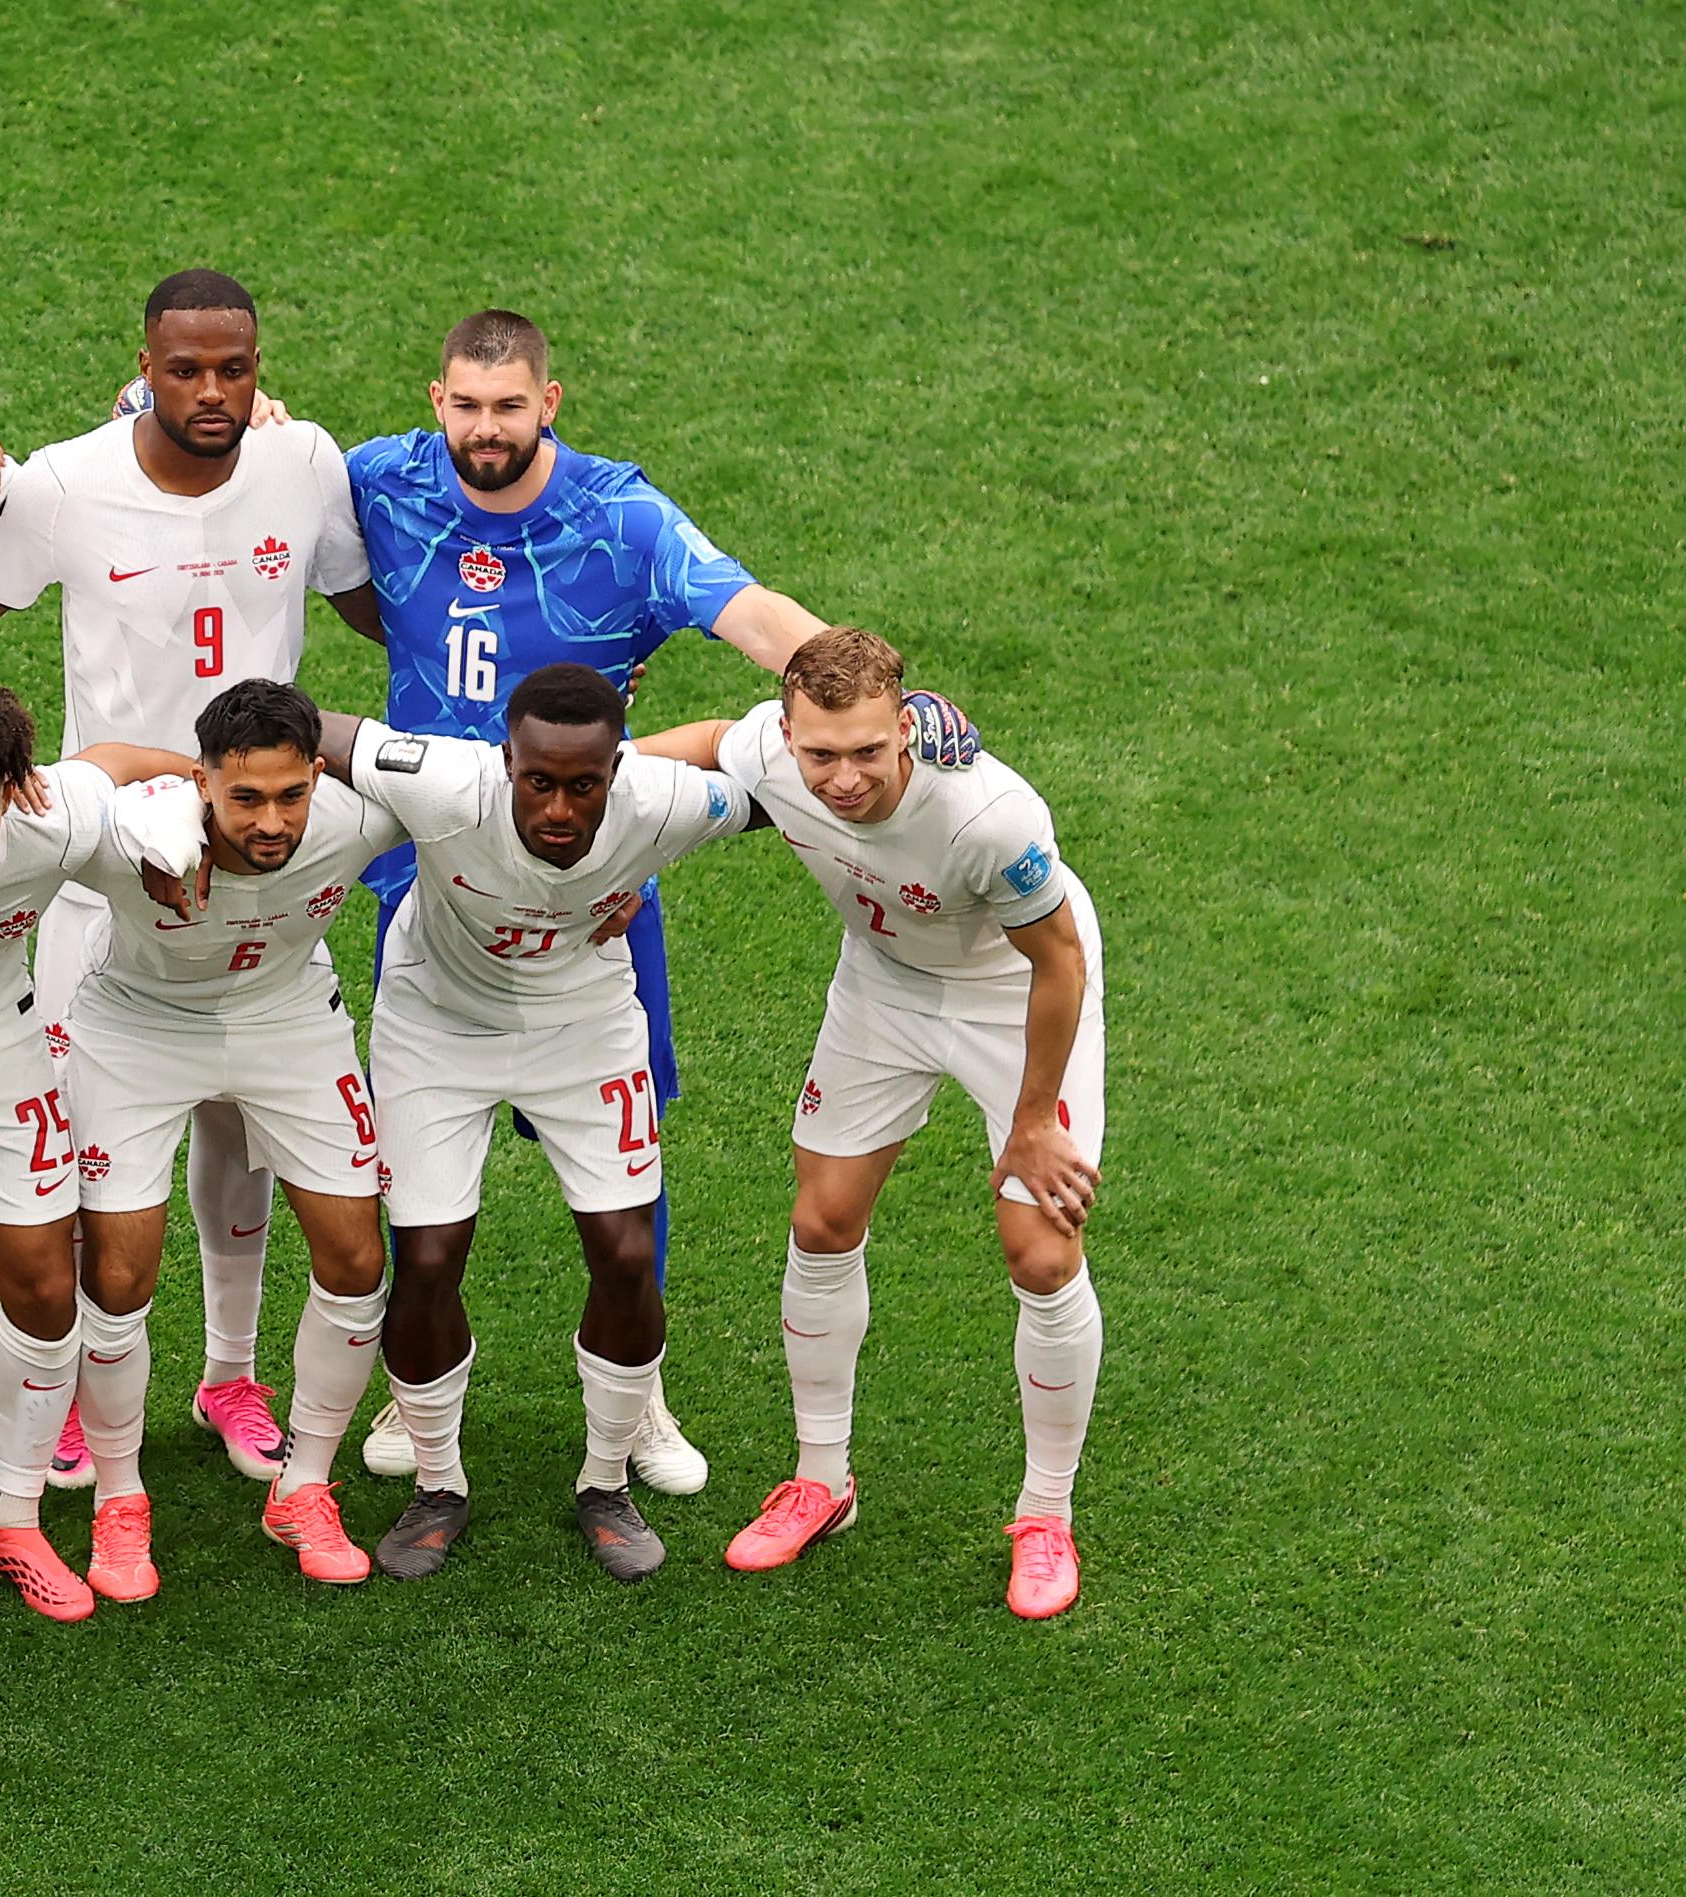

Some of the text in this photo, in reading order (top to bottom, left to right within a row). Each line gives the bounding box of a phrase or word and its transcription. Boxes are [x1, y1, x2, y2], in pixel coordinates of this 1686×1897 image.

[252, 552, 291, 565] CANADA
[460, 563, 503, 576] CANADA
[194, 607, 223, 678] 9
[445, 626, 498, 702] 16
[856, 893, 897, 937] 2
[228, 941, 267, 971] 6
[15, 1087, 75, 1172] 25
[336, 1073, 376, 1146] 6
[600, 1070, 659, 1153] 22
[77, 1158, 111, 1168] CANADA
